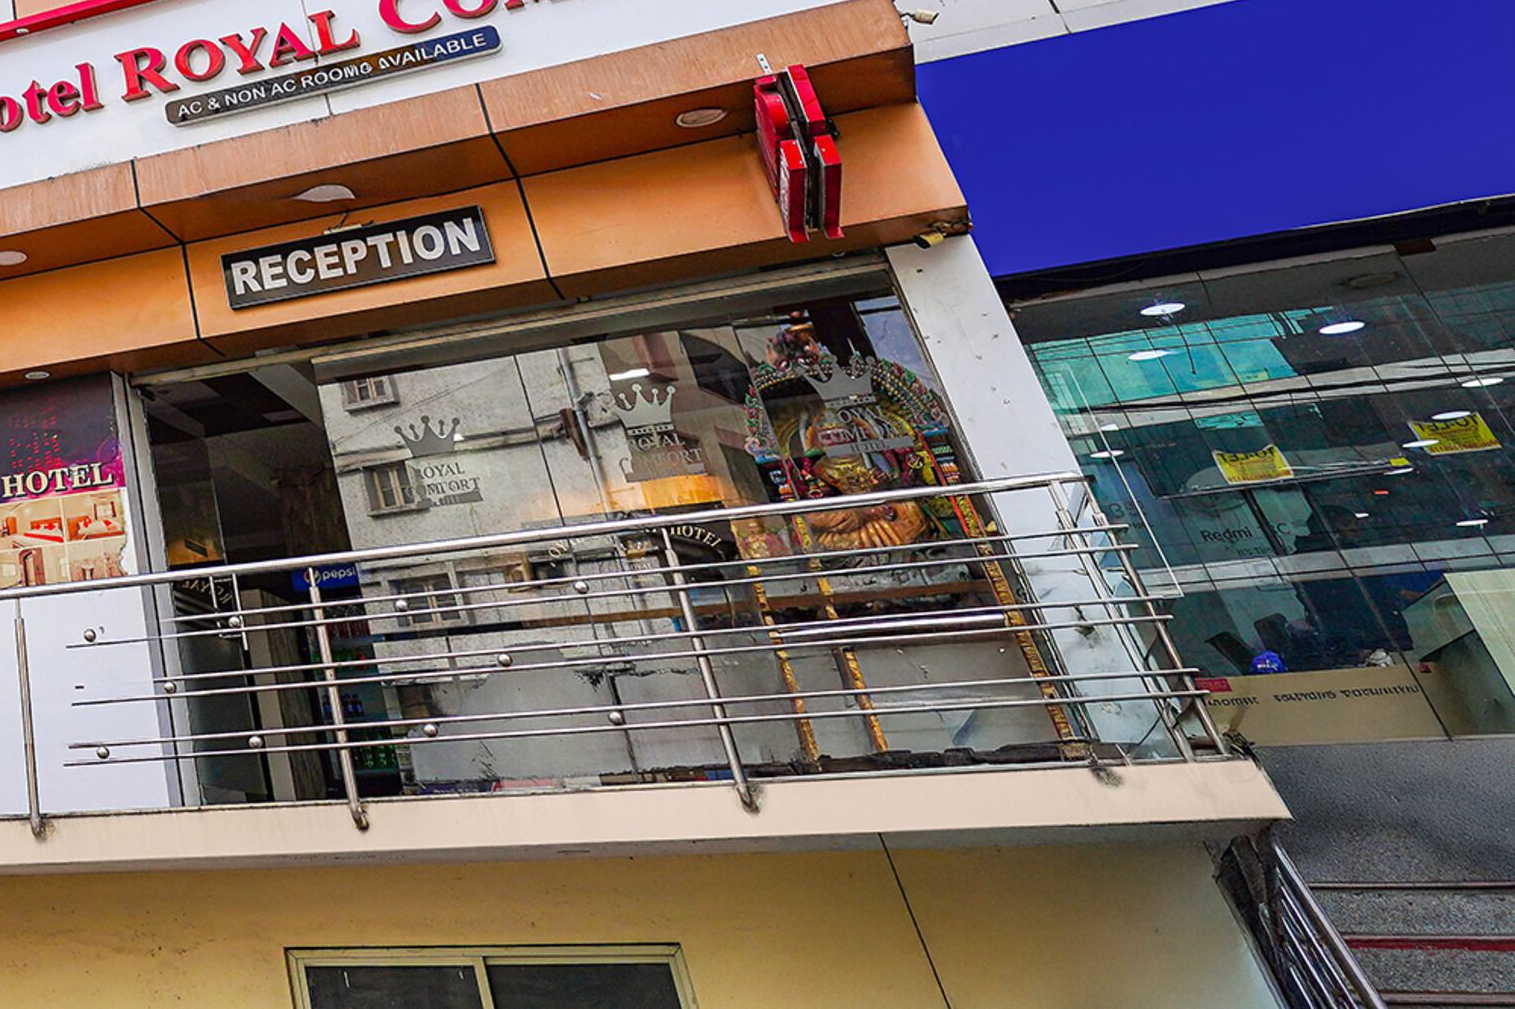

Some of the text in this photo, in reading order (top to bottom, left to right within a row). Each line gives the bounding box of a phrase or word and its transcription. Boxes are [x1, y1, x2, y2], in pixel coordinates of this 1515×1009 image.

[114, 10, 360, 101] ROYAL
[177, 100, 202, 118] AC
[207, 96, 221, 111] &
[224, 88, 266, 107] NON
[271, 79, 297, 94] AC
[378, 33, 486, 69] AVAILABLE
[231, 217, 481, 295] RECEPTION
[1, 462, 115, 500] HOTEL
[1200, 526, 1252, 544] Redmi
[321, 566, 357, 582] pepsi
